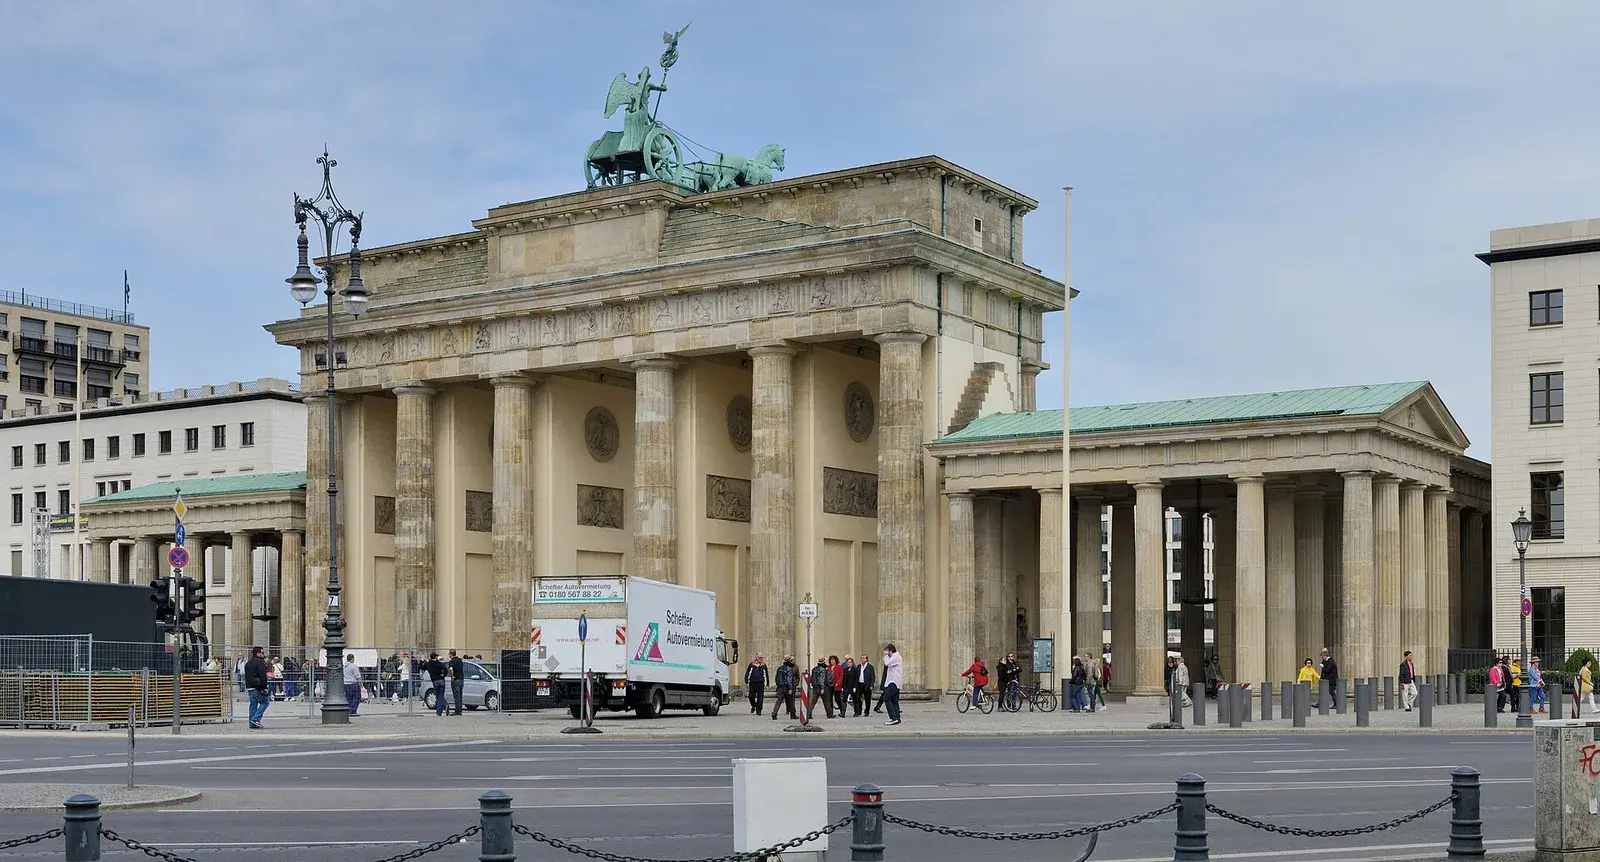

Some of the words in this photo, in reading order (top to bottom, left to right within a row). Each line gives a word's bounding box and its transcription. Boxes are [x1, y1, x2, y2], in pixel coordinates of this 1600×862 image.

[1520, 585, 1526, 594] 5
[666, 609, 693, 627] Schefter
[666, 630, 714, 652] Autovermietung
